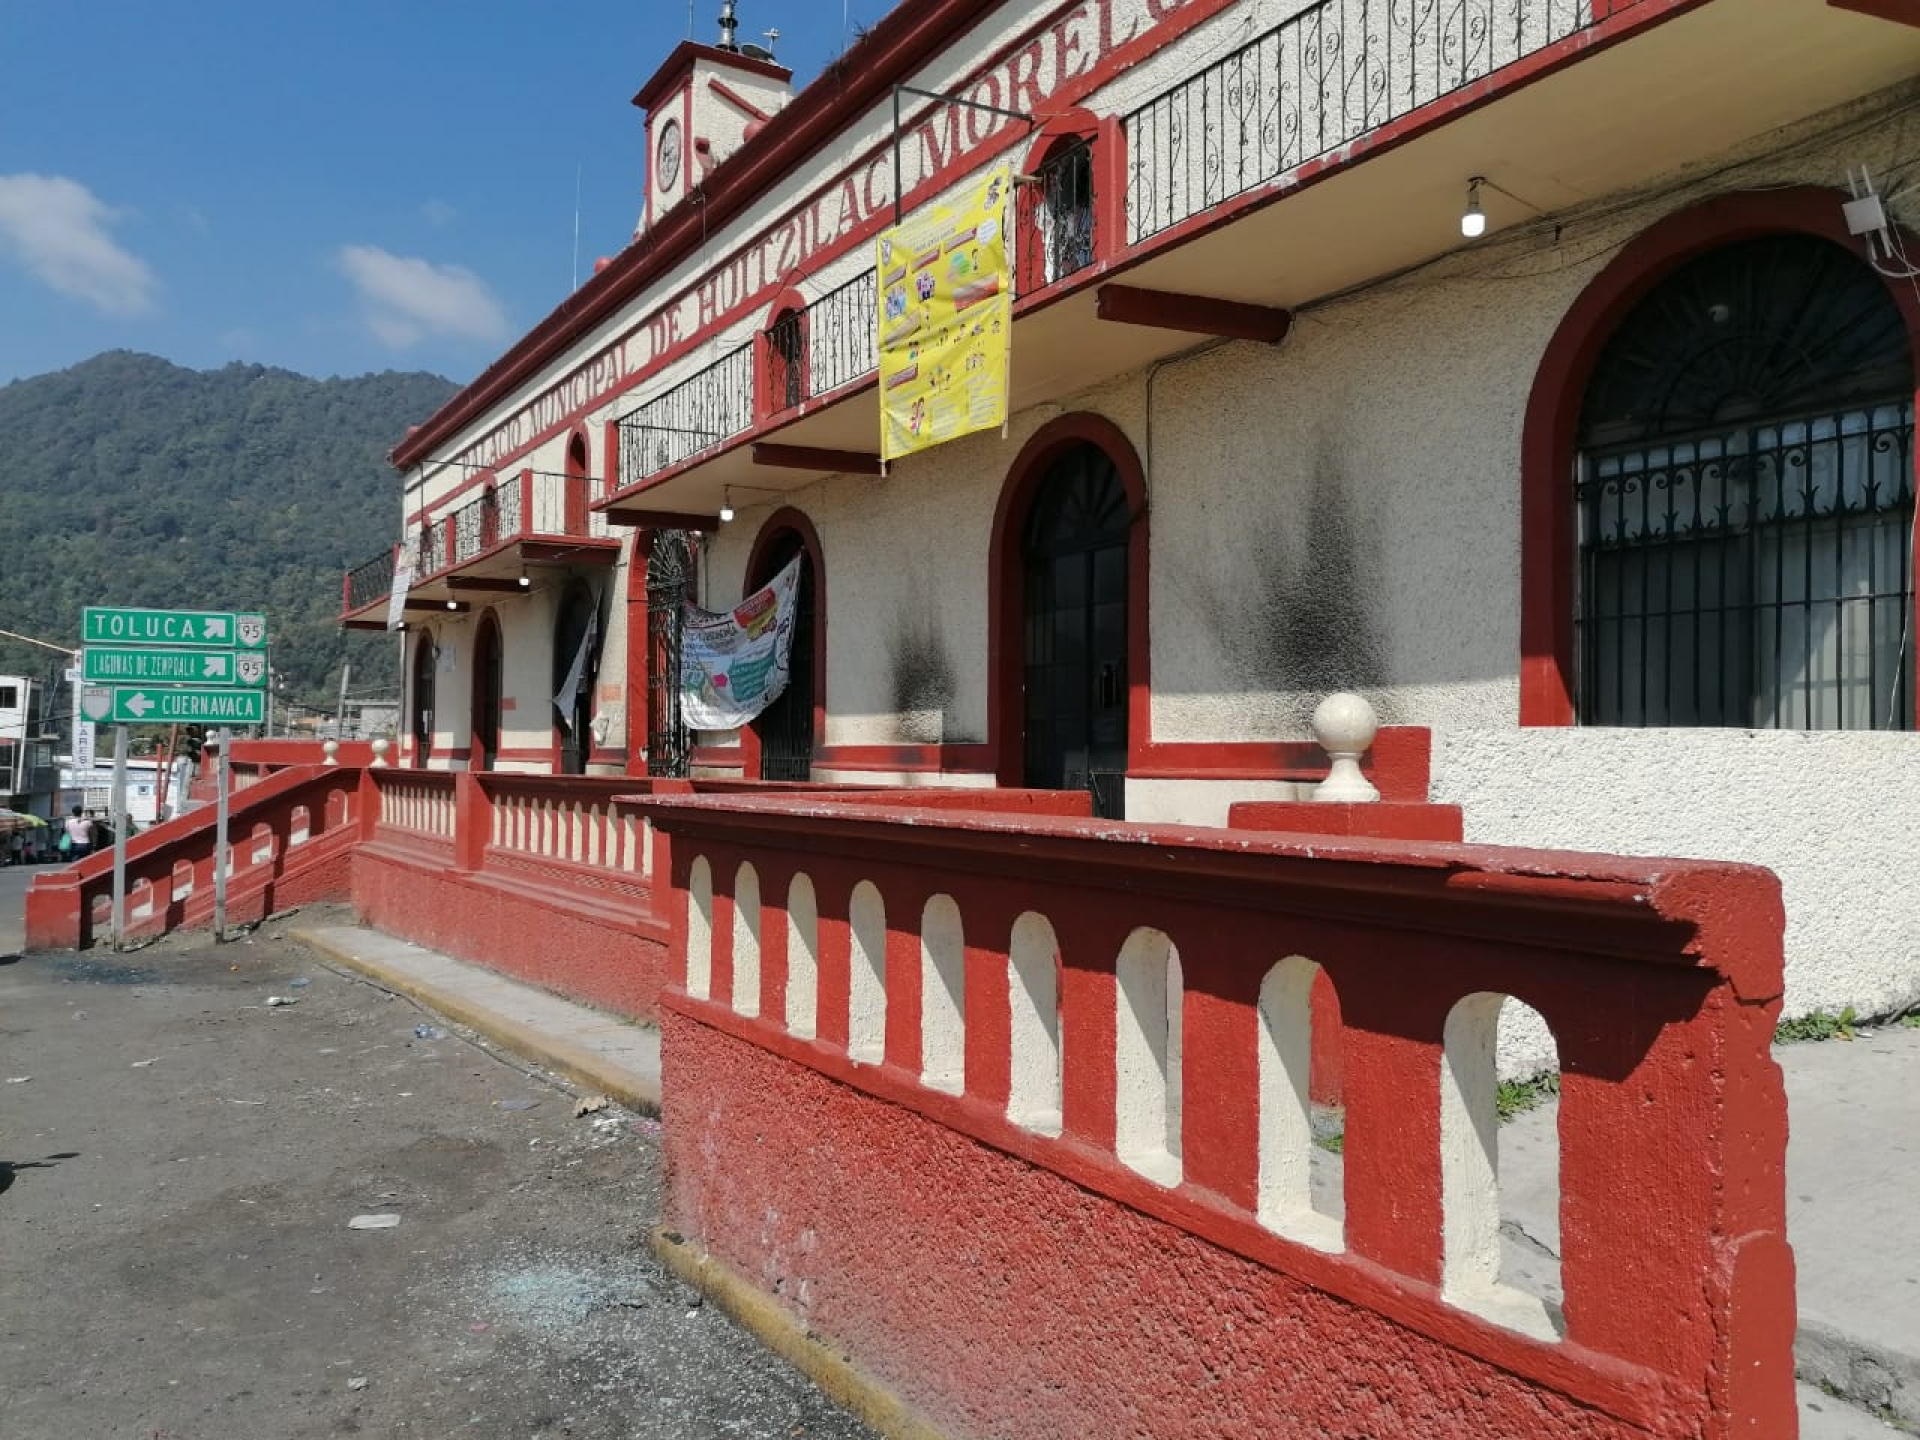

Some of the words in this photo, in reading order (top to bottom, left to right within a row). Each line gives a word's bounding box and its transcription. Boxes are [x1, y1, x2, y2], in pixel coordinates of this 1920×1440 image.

[464, 417, 520, 480] PALACIO
[529, 340, 635, 439] MUNICIPAL
[650, 305, 683, 358] DE
[698, 153, 888, 327] HUITZILAC
[94, 614, 195, 638] TOLUCA
[243, 624, 259, 638] 95
[93, 654, 133, 675] LAGUNAS
[137, 656, 148, 675] DE
[150, 656, 195, 678] ZEMPOALA
[243, 662, 259, 676] 95
[161, 695, 254, 716] CUERNAVACA
